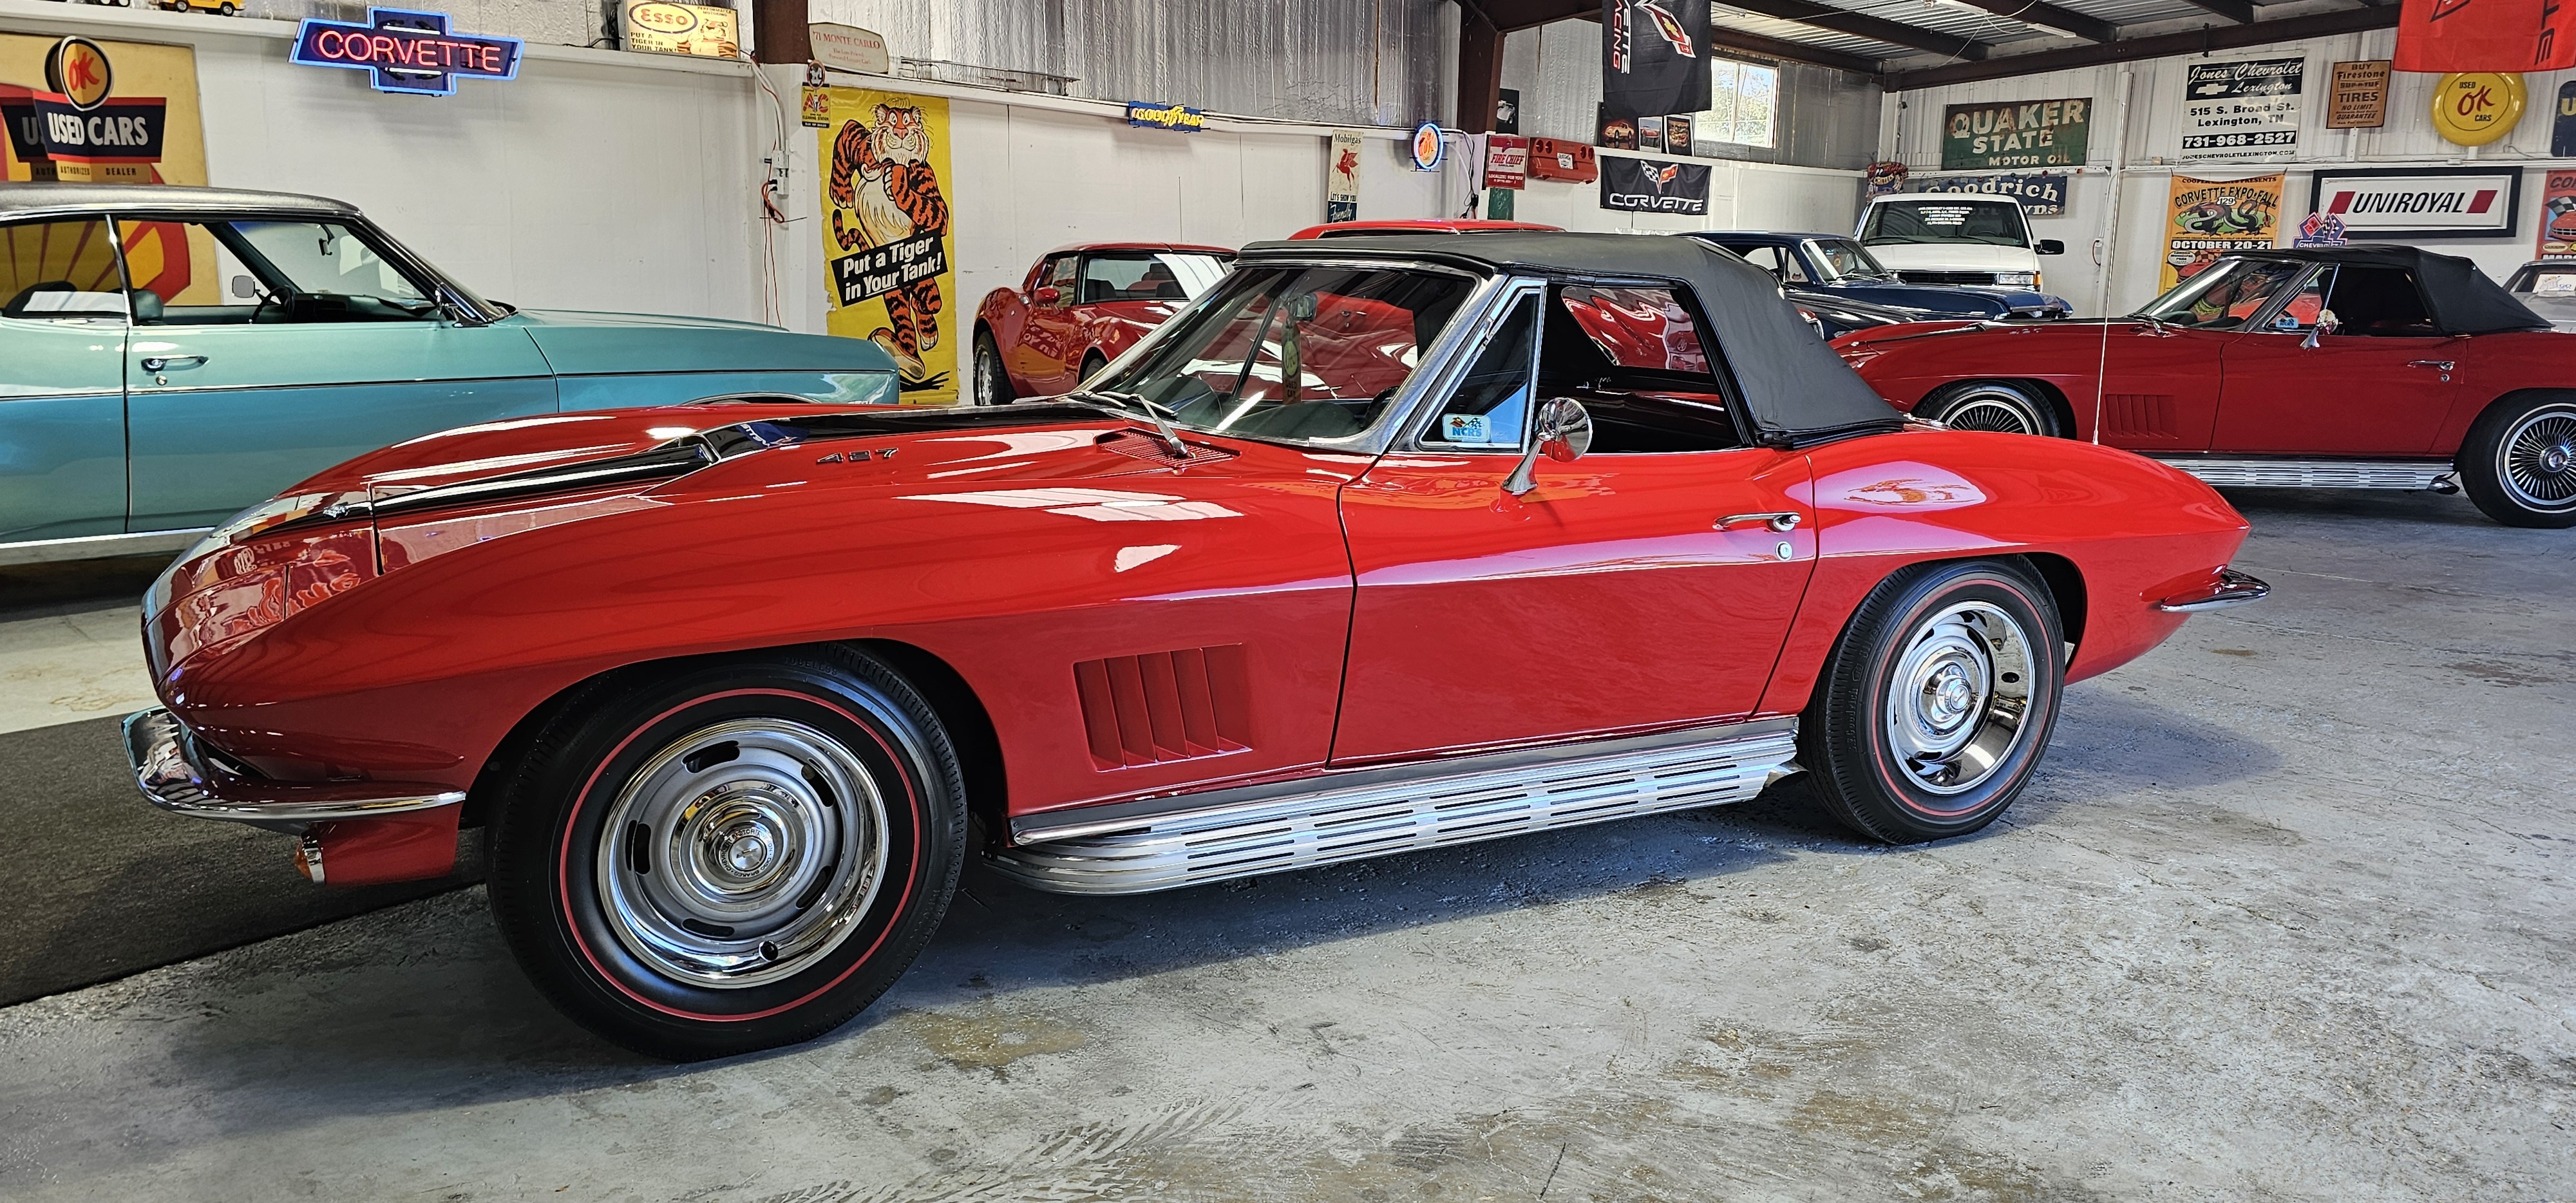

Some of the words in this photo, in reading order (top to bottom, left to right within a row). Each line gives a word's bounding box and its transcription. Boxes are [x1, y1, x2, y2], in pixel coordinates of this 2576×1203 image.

[823, 33, 852, 45] MONTE
[854, 38, 880, 49] CARLO
[318, 31, 502, 72] CORVETTE
[69, 52, 100, 91] OK
[2188, 66, 2229, 85] Jones
[2234, 61, 2303, 81] Chevrolet
[2336, 71, 2385, 81] Firestone
[2231, 81, 2294, 95] Lexington
[2338, 91, 2379, 103] TIRES
[2457, 85, 2496, 116] OK
[1132, 106, 1204, 127] GOODYEAR
[2190, 107, 2211, 117] 515
[2216, 106, 2228, 115] S.
[2233, 103, 2271, 114] Broad
[2277, 102, 2295, 111] St.
[1949, 99, 2085, 139] QUAKER
[2197, 117, 2262, 128] Lexington,
[2268, 114, 2284, 123] TN
[48, 112, 85, 145] USED
[88, 117, 149, 146] CARS
[1334, 133, 1361, 146] Mobilgas
[1973, 130, 2054, 154] STATE
[2184, 131, 2295, 148] 731-968-2527
[1491, 154, 1505, 163] FIRE
[1506, 155, 1524, 165] CHIEF
[1989, 155, 2040, 166] MOTOR
[2182, 150, 2295, 160] JONESCHEVROLETLEXINGTON.COM
[61, 166, 90, 176] AUTHORIZED
[106, 167, 137, 176] DEALER
[1610, 193, 1703, 212] CORVETTE
[2175, 187, 2226, 207] CORVETTE
[2353, 193, 2465, 213] UNIROYAL
[2172, 240, 2231, 249] OCTOBER
[2234, 241, 2272, 250] 20-21
[843, 254, 871, 278] Put
[875, 252, 886, 268] a
[889, 236, 934, 263] Tiger
[846, 282, 861, 301] in
[863, 271, 900, 294] Your
[901, 252, 942, 283] Tank!
[1452, 427, 1482, 437] NCRS
[816, 447, 900, 463] 427
[784, 657, 837, 677] TUBELESS
[732, 829, 755, 838] MOTOR
